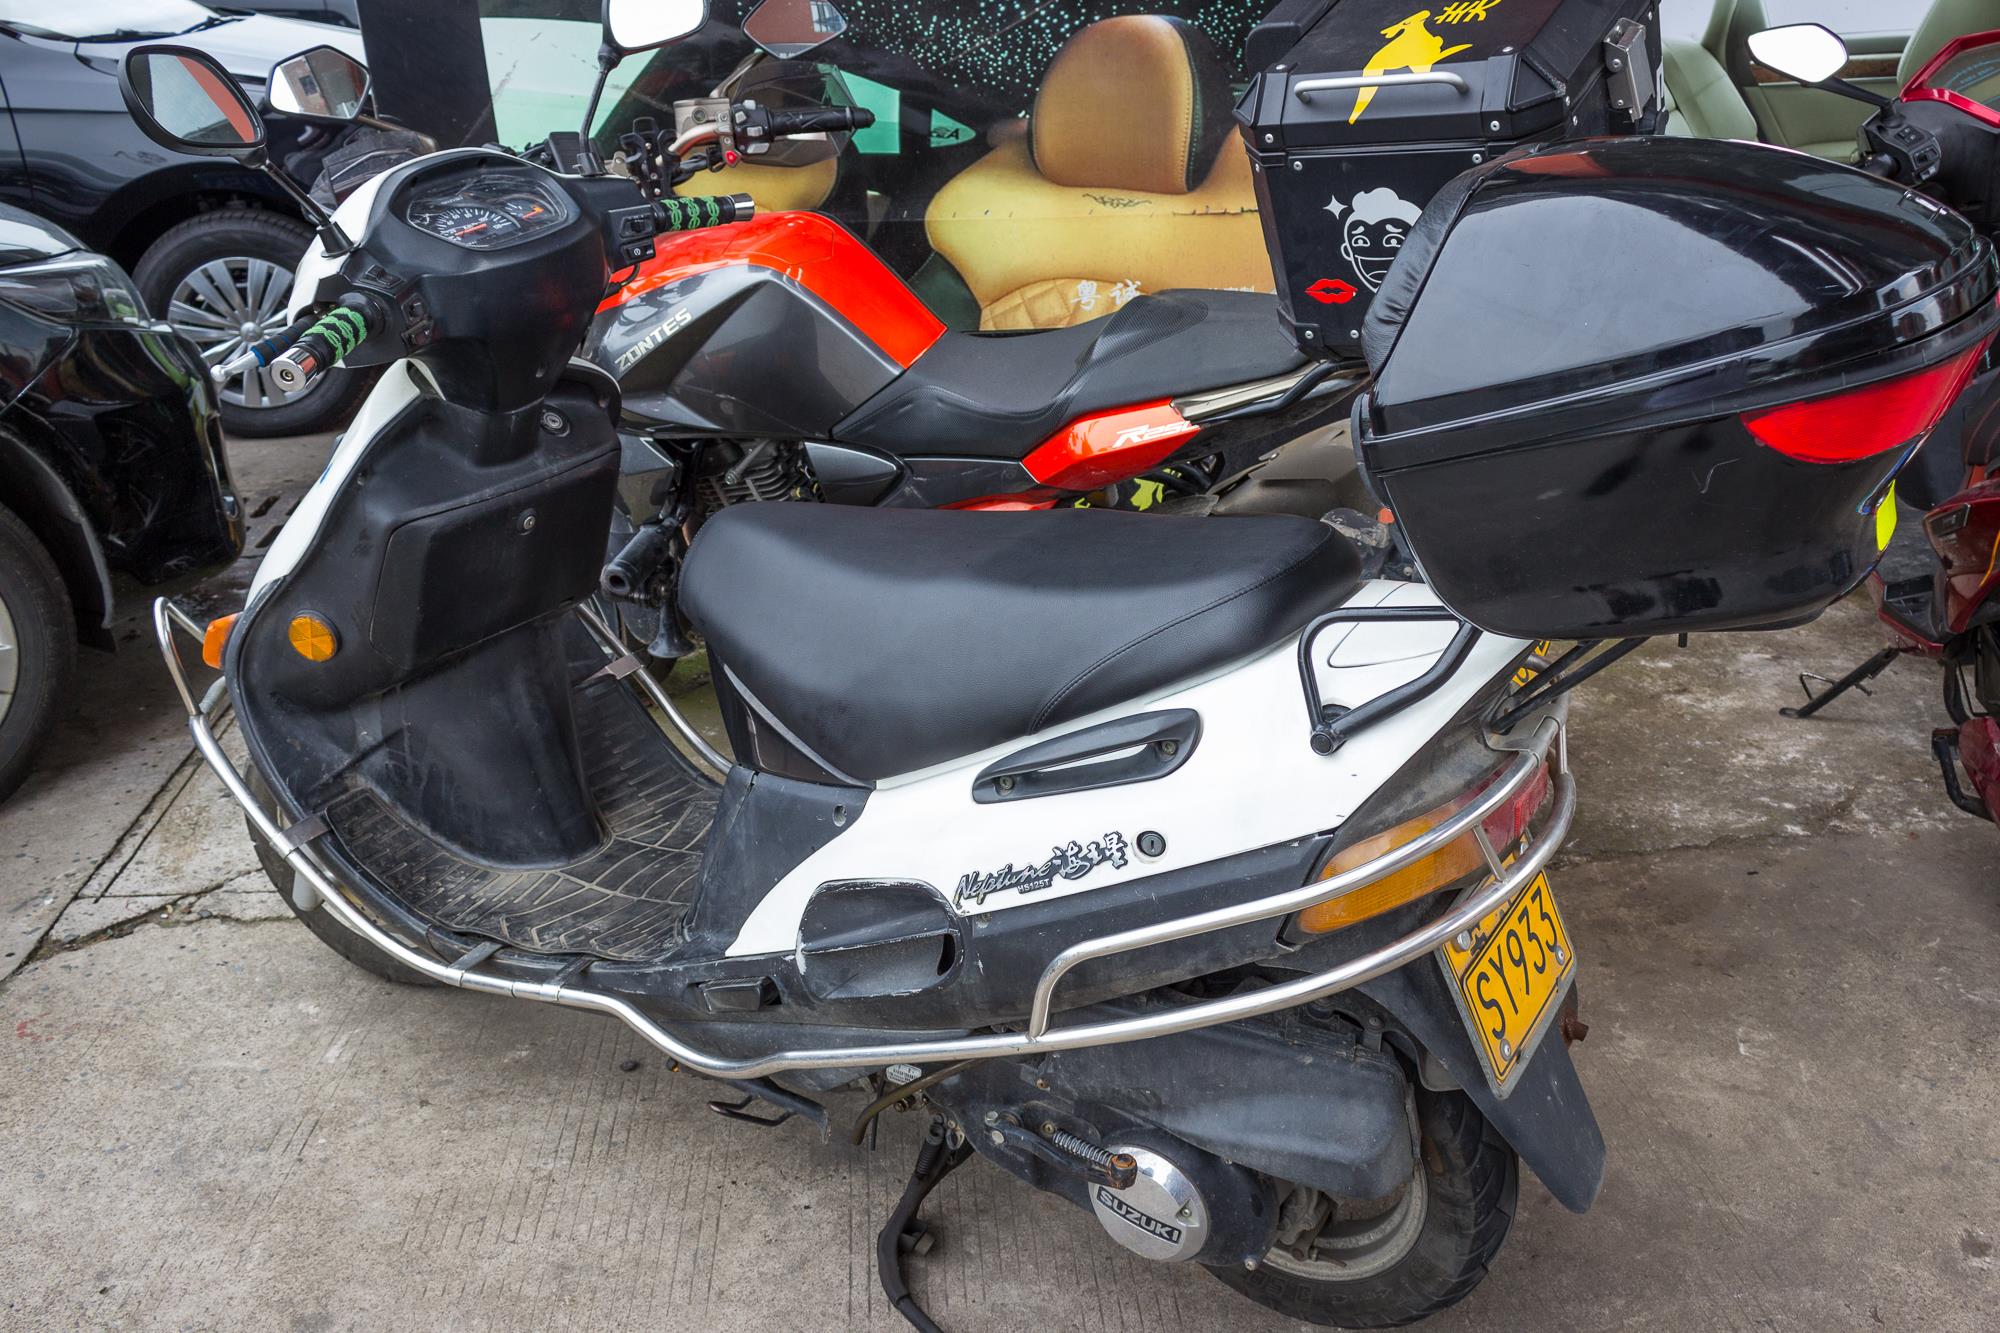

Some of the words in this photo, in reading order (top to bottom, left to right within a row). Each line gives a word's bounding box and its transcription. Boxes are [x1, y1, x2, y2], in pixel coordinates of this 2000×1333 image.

[614, 307, 693, 372] ZONTES
[953, 863, 1052, 905] Neptune
[1052, 831, 1128, 880] 海王星
[1017, 878, 1051, 893] HS125T
[1476, 885, 1558, 1041] SY933
[1099, 1189, 1181, 1242] SUZUKI
